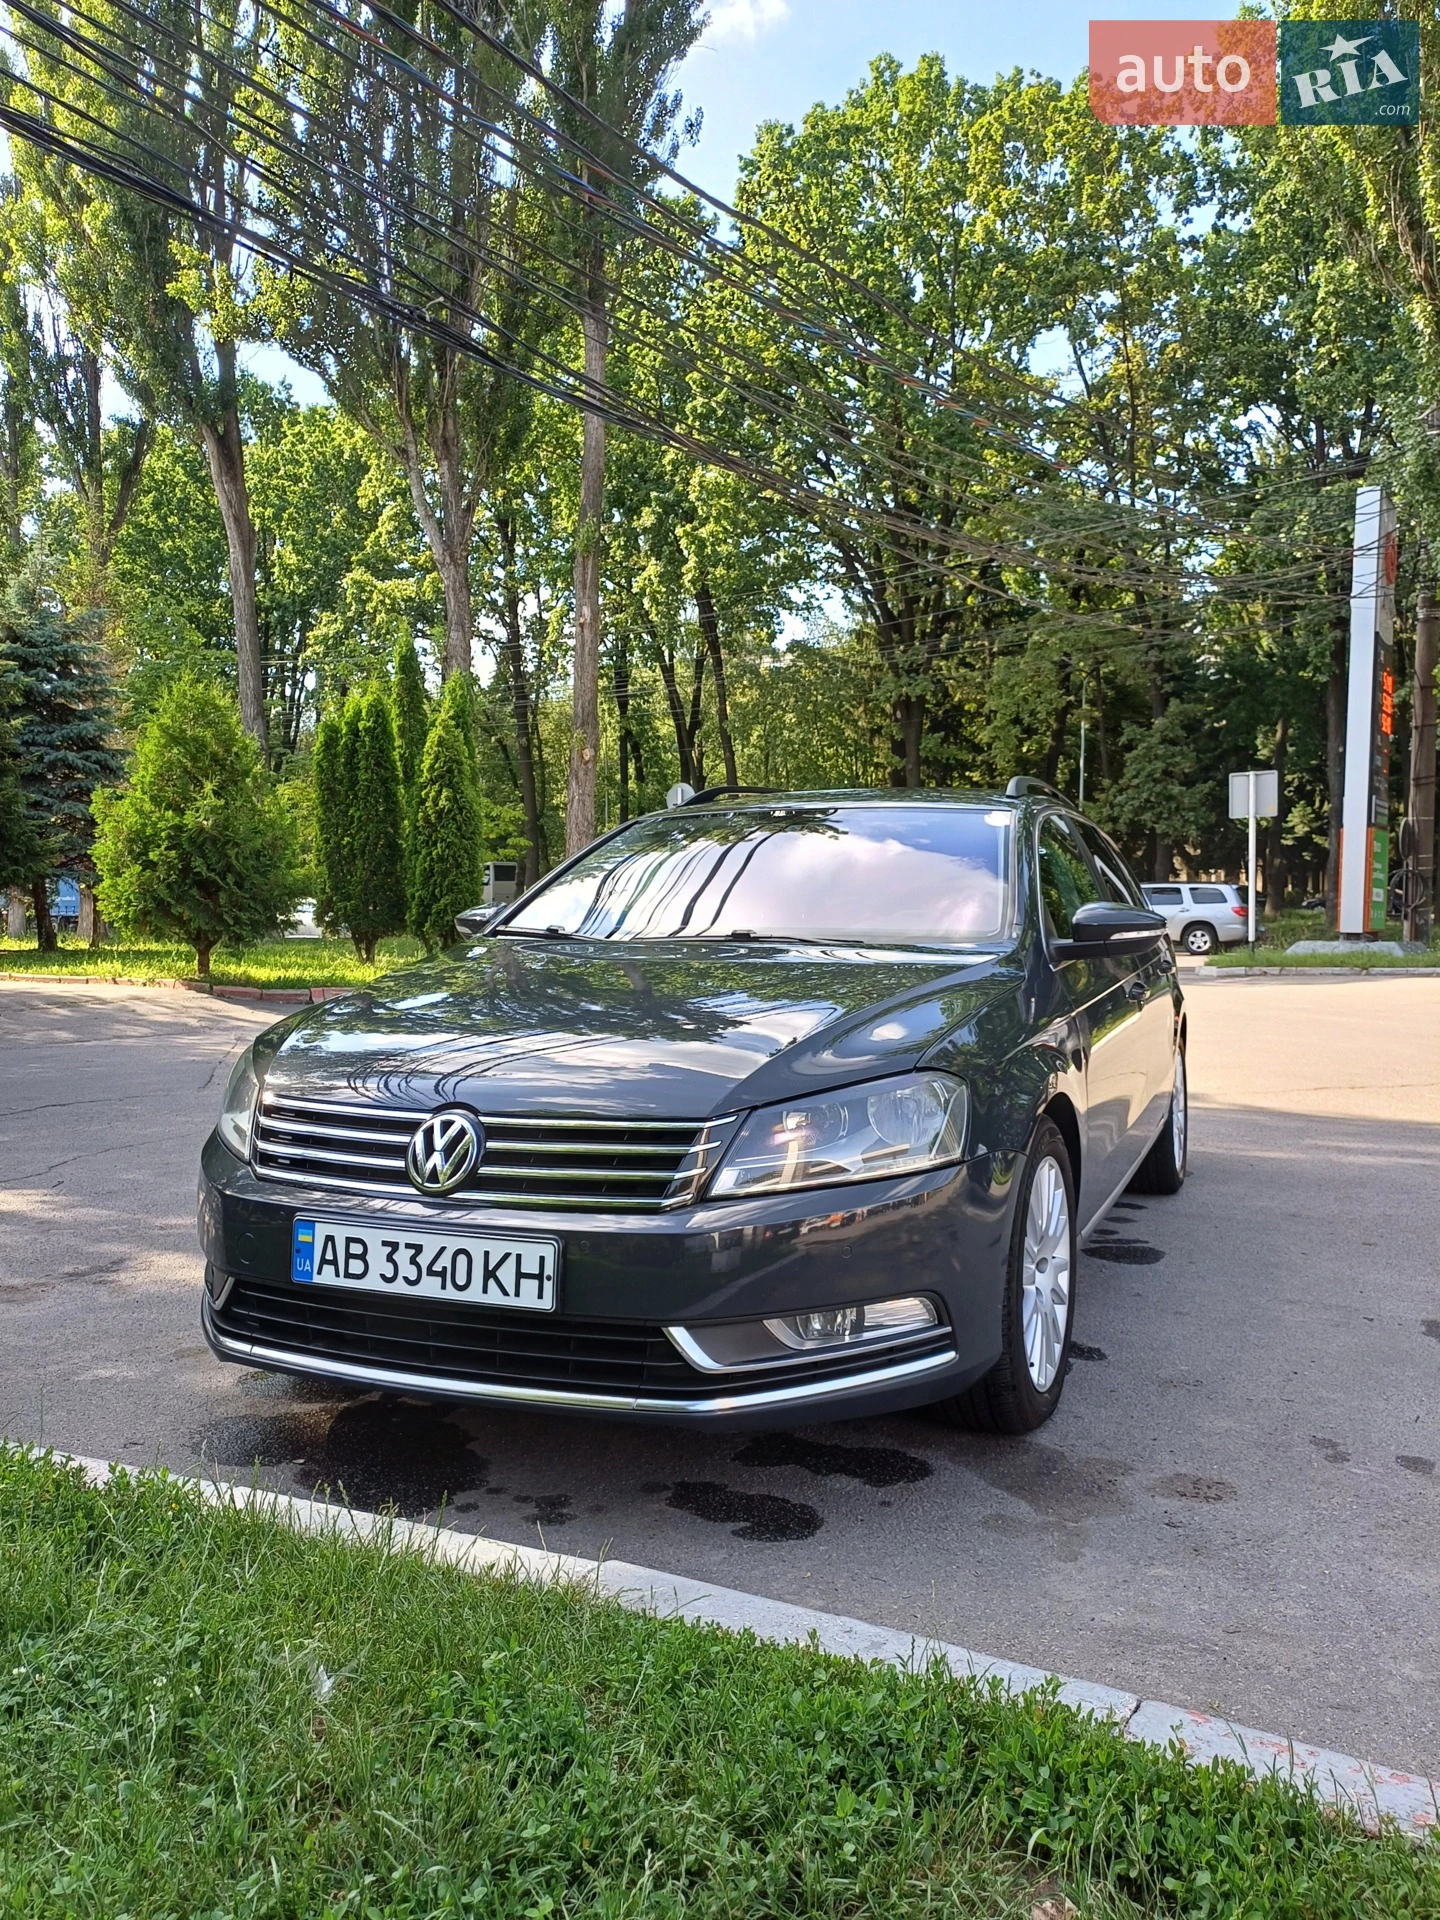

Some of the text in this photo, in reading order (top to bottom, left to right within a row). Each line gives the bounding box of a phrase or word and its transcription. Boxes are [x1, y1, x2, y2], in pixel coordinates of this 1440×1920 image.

[296, 1257, 311, 1272] UA
[317, 1234, 546, 1300] AB 3340 KH
